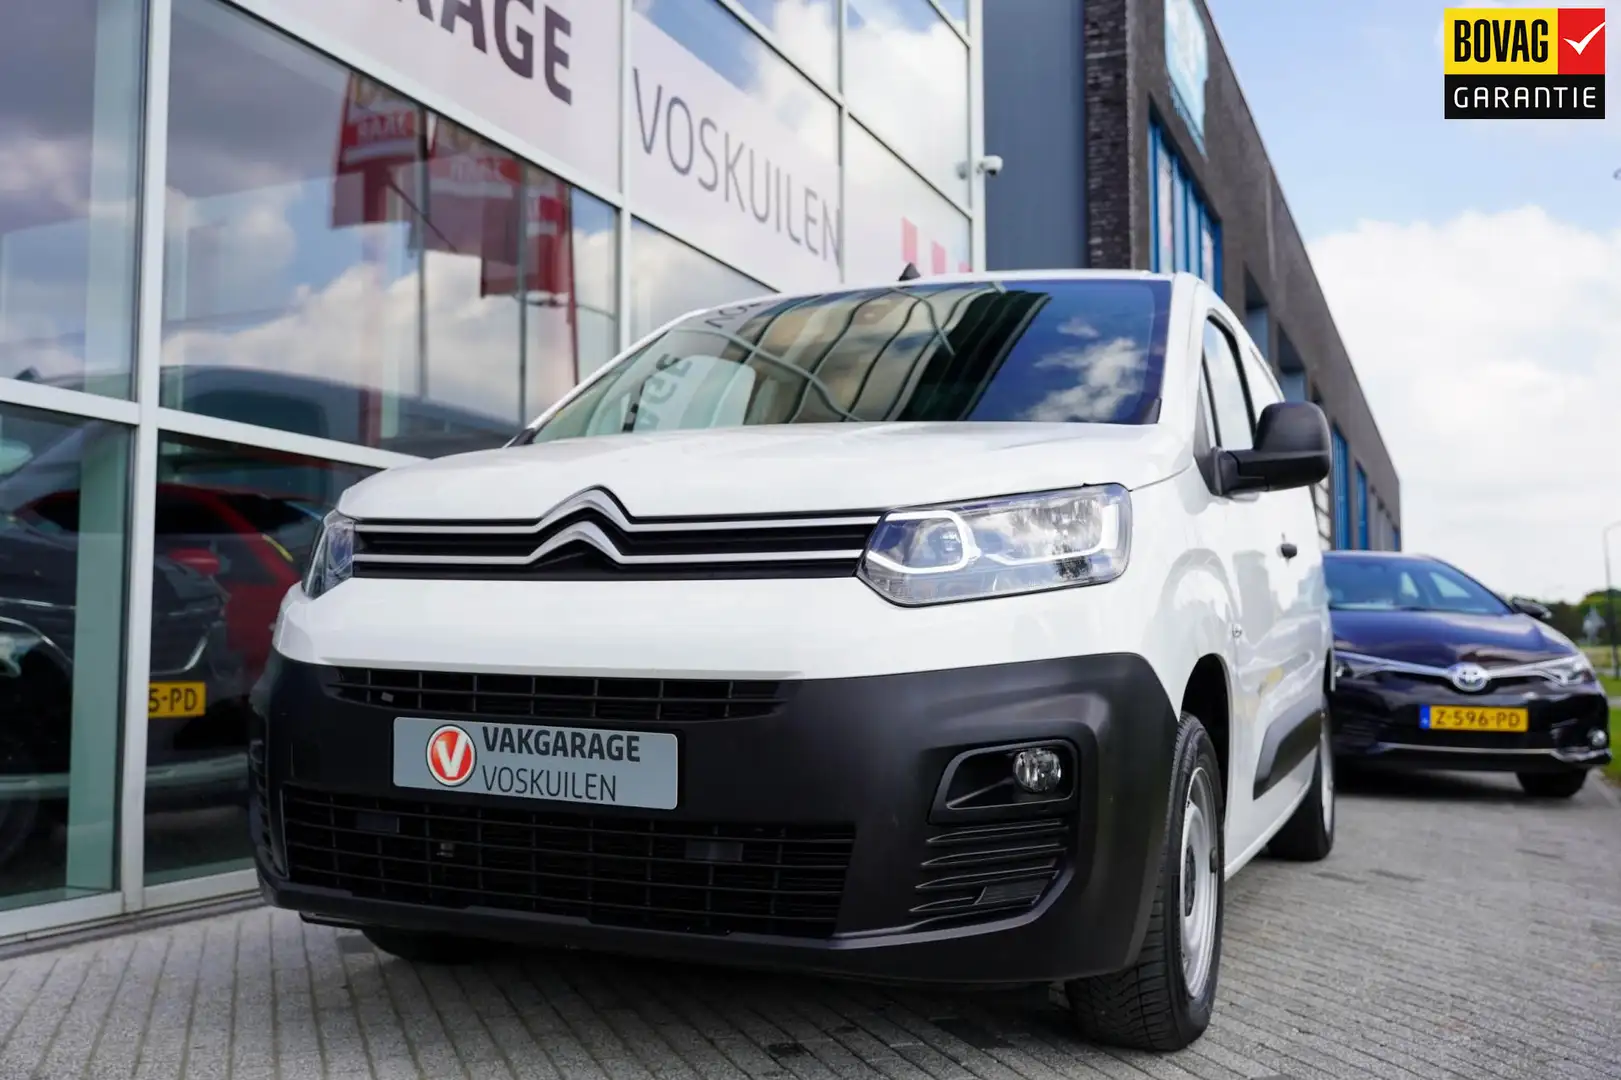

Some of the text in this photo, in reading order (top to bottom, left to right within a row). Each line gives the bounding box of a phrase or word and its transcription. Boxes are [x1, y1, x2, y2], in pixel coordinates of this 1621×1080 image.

[632, 67, 842, 268] VOSKUILEN
[1435, 708, 1521, 729] Z-596-PD
[482, 726, 641, 762] VAKGARAGE
[482, 765, 617, 802] VOSKUILEN
